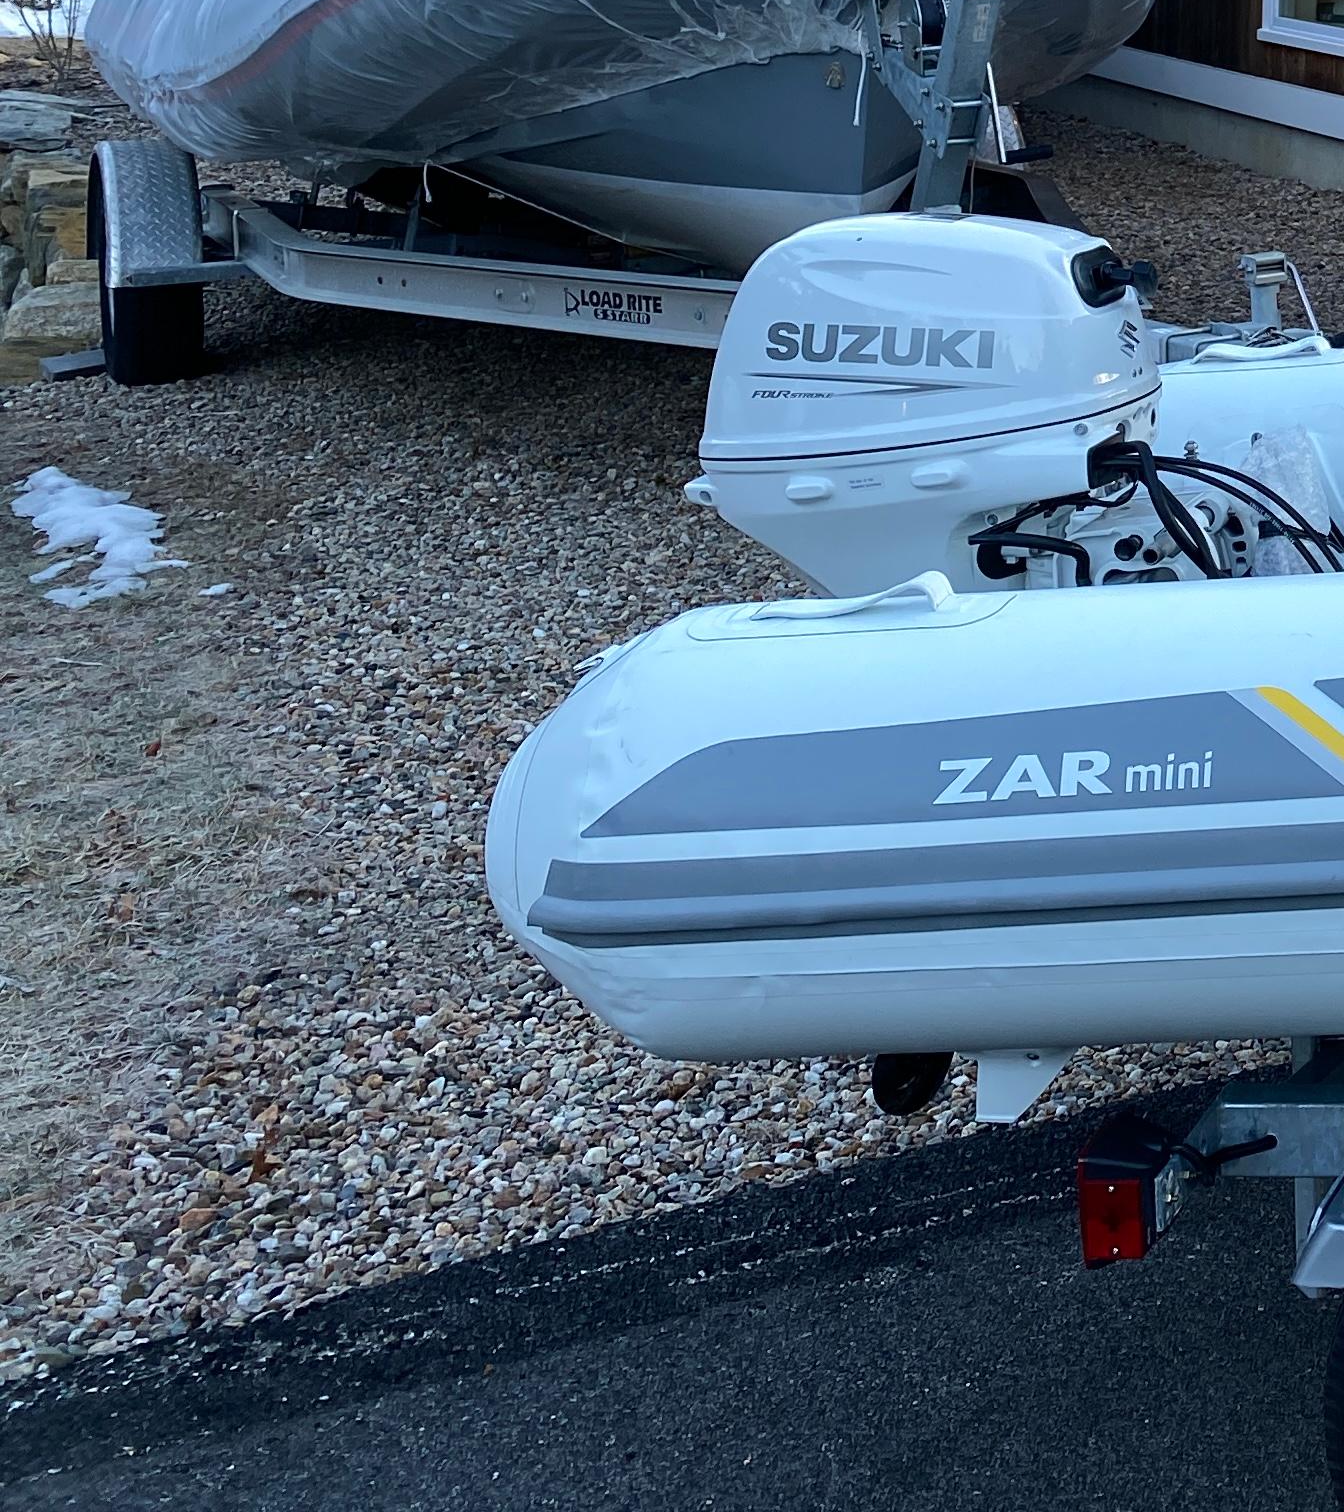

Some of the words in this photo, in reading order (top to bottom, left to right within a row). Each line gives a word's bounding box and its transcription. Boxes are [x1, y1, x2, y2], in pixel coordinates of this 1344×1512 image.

[580, 289, 624, 310] LOAD
[626, 293, 663, 314] RITE
[765, 321, 996, 369] SUZUKI
[751, 390, 791, 399] FOUR
[932, 750, 1112, 805] ZAR
[1124, 750, 1214, 793] mini
